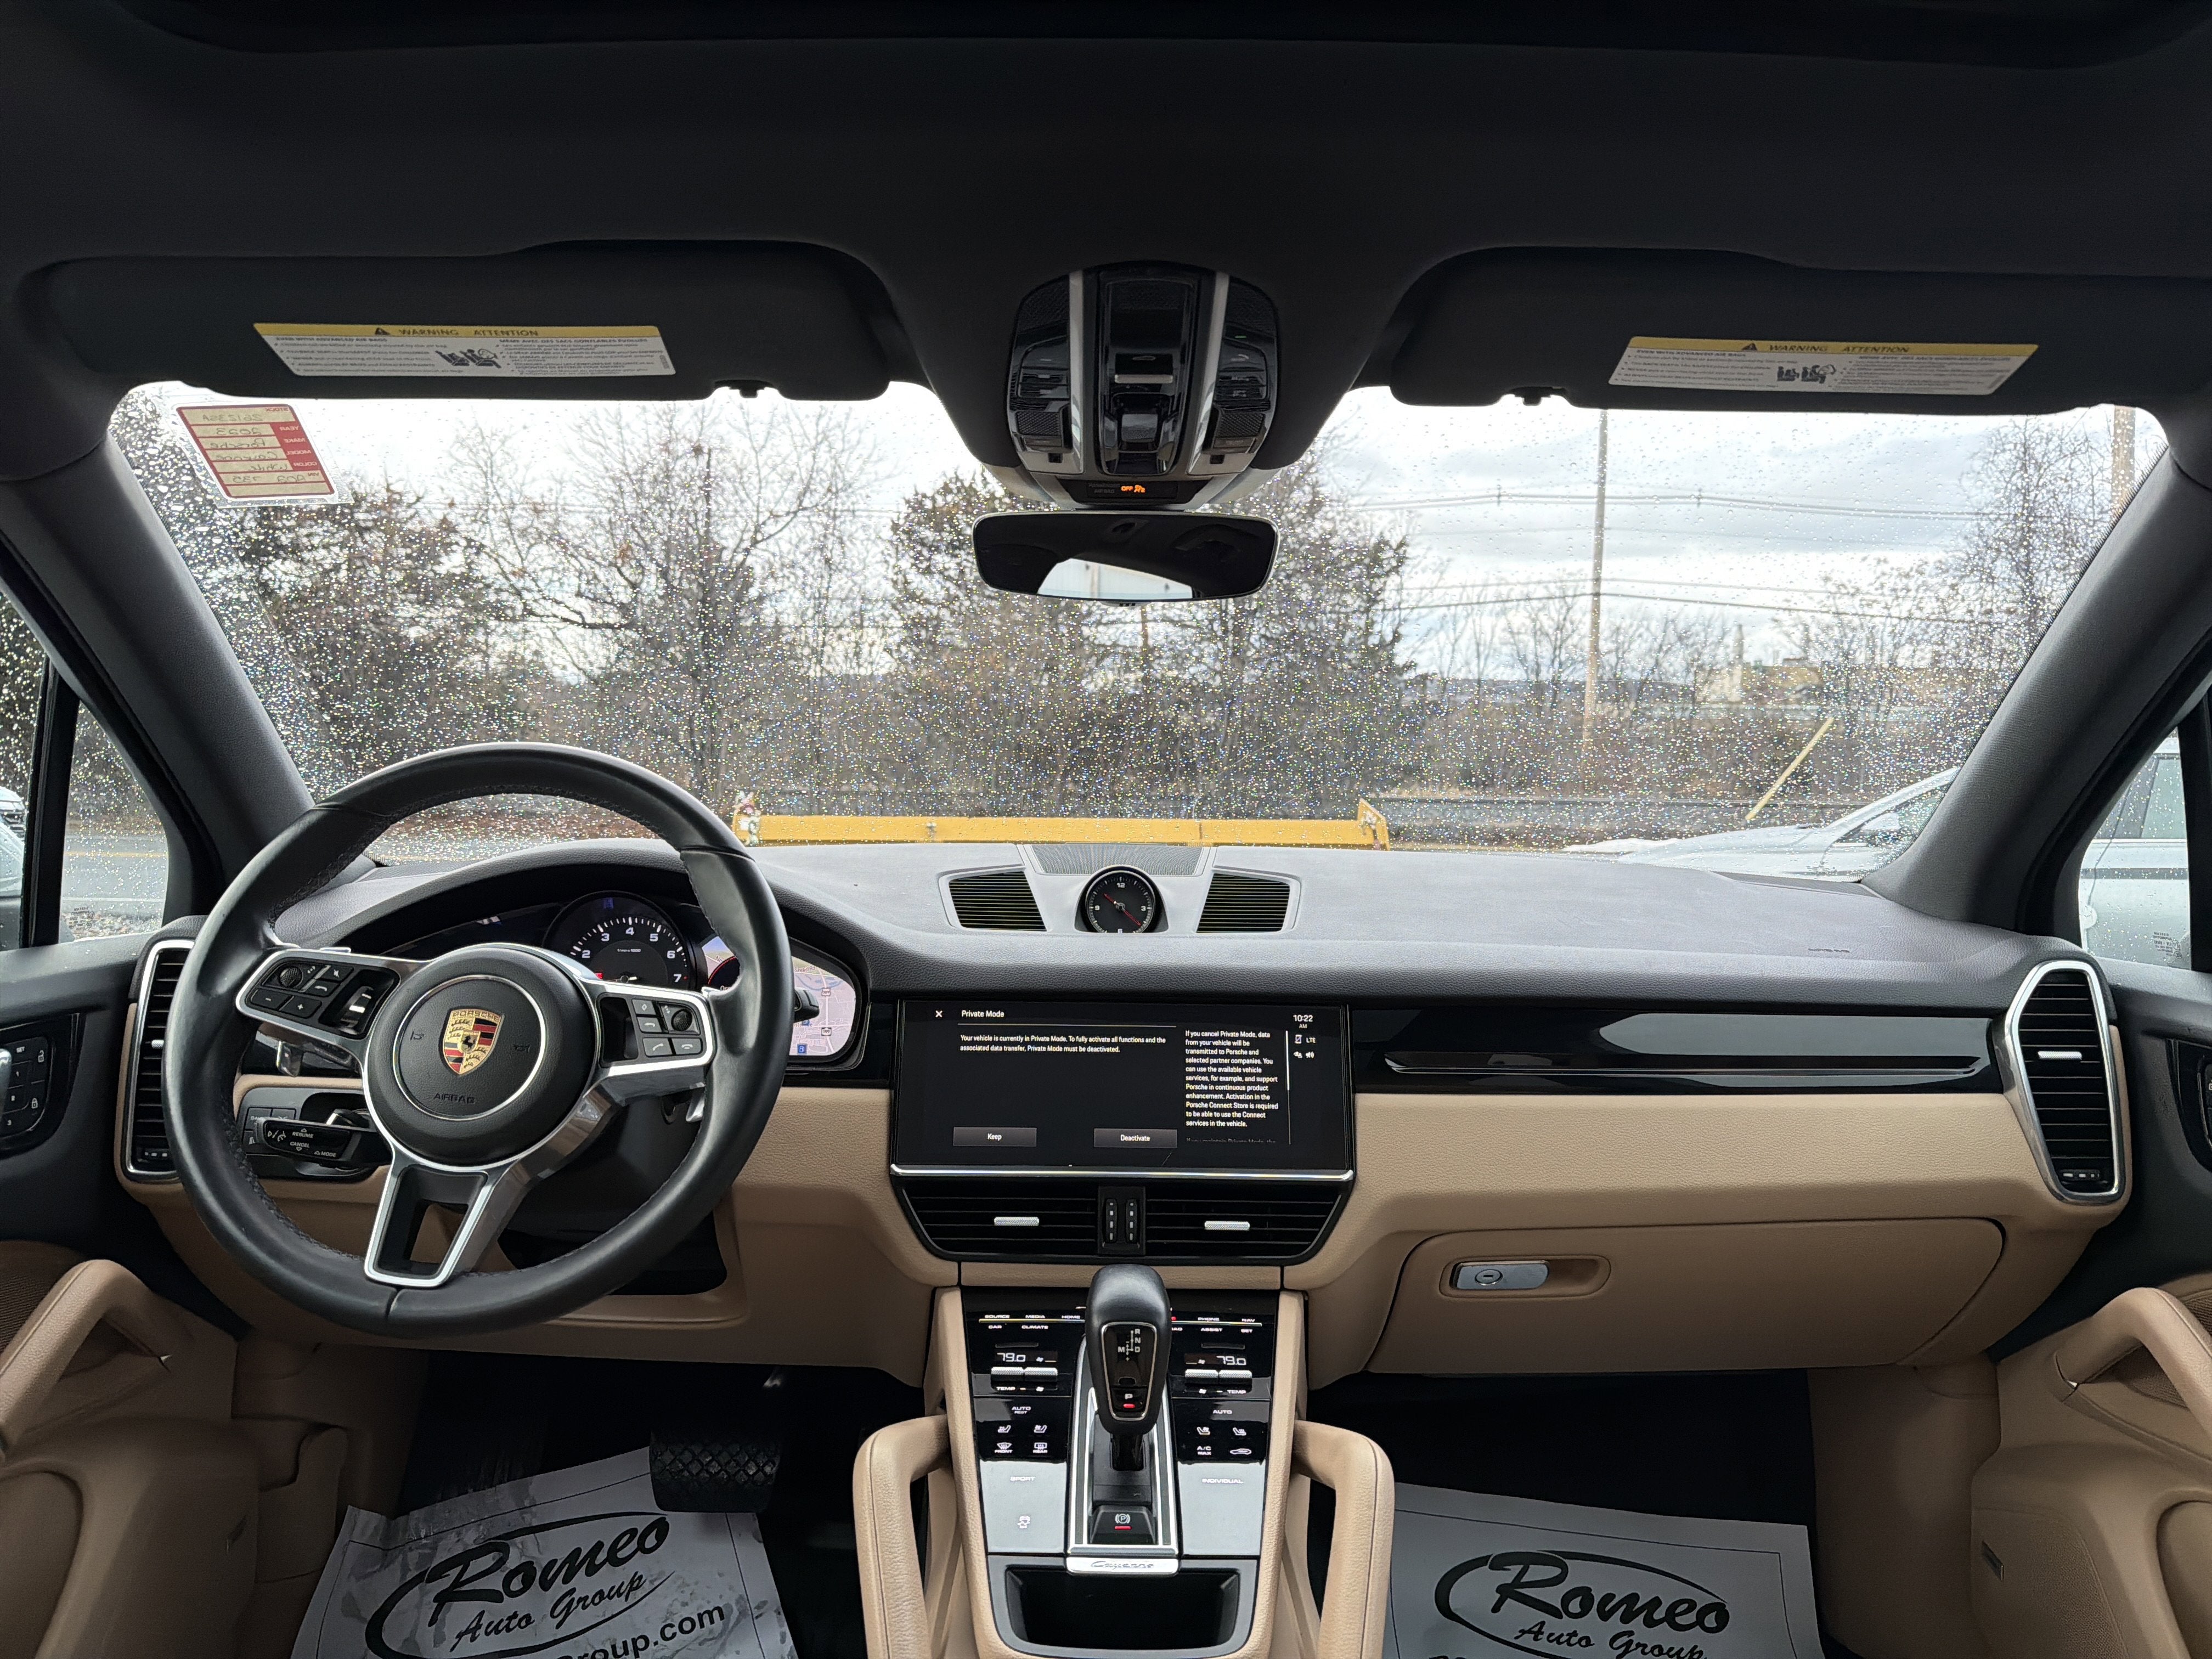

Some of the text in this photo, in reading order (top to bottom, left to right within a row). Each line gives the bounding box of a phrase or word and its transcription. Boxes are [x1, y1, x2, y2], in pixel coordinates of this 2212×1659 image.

[1768, 345, 1827, 353] WARNING
[601, 933, 610, 941] 3
[650, 933, 658, 941] 5
[582, 950, 590, 958] 2
[667, 950, 675, 958] 6
[674, 974, 681, 983] 7
[453, 1011, 500, 1022] PORSCHE
[433, 1093, 475, 1104] AIRBAG
[988, 1133, 1002, 1141] Keep
[997, 1352, 1026, 1362] 79.0
[1216, 1356, 1246, 1365] 79.0
[1091, 1561, 1154, 1570] Cayenne
[425, 1517, 670, 1627] Romeo
[1488, 1551, 1730, 1634] Romeo
[450, 1571, 647, 1652] Auto Group
[1514, 1621, 1706, 1659] Auto Group
